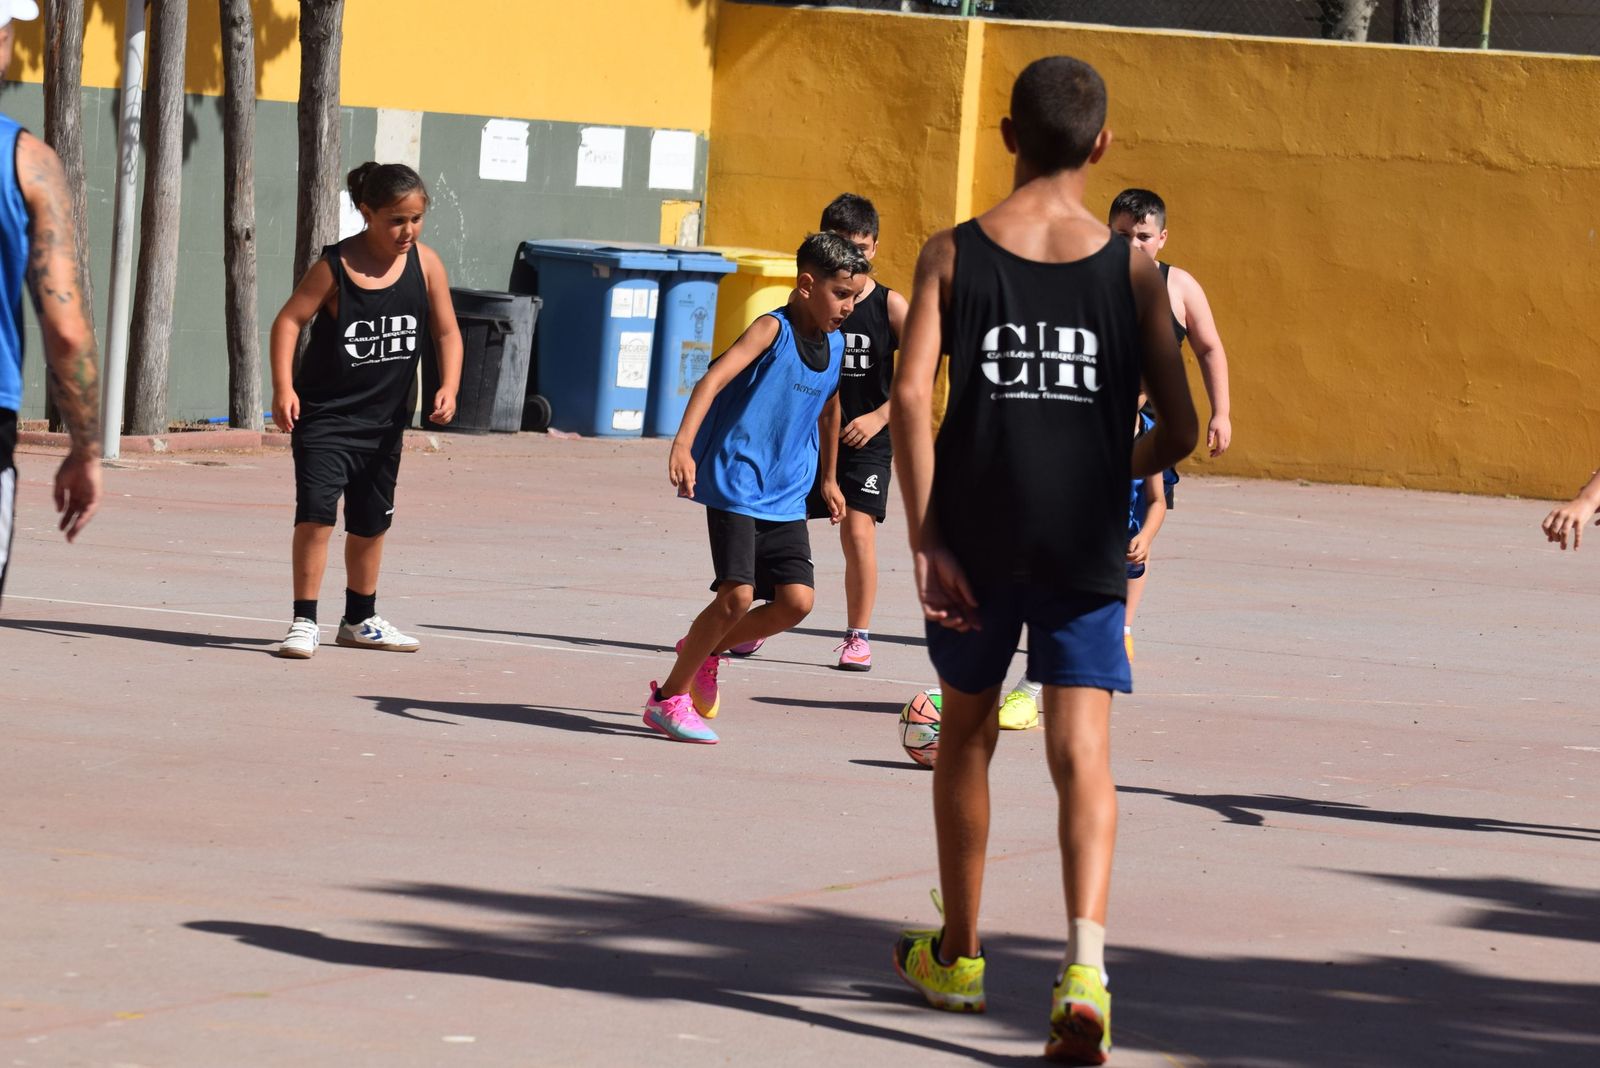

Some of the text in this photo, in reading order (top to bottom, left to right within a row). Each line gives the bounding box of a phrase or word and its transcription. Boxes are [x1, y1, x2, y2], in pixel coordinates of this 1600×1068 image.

[986, 350, 1097, 364] CARLOS REQUENA
[1041, 391, 1094, 404] financiero
